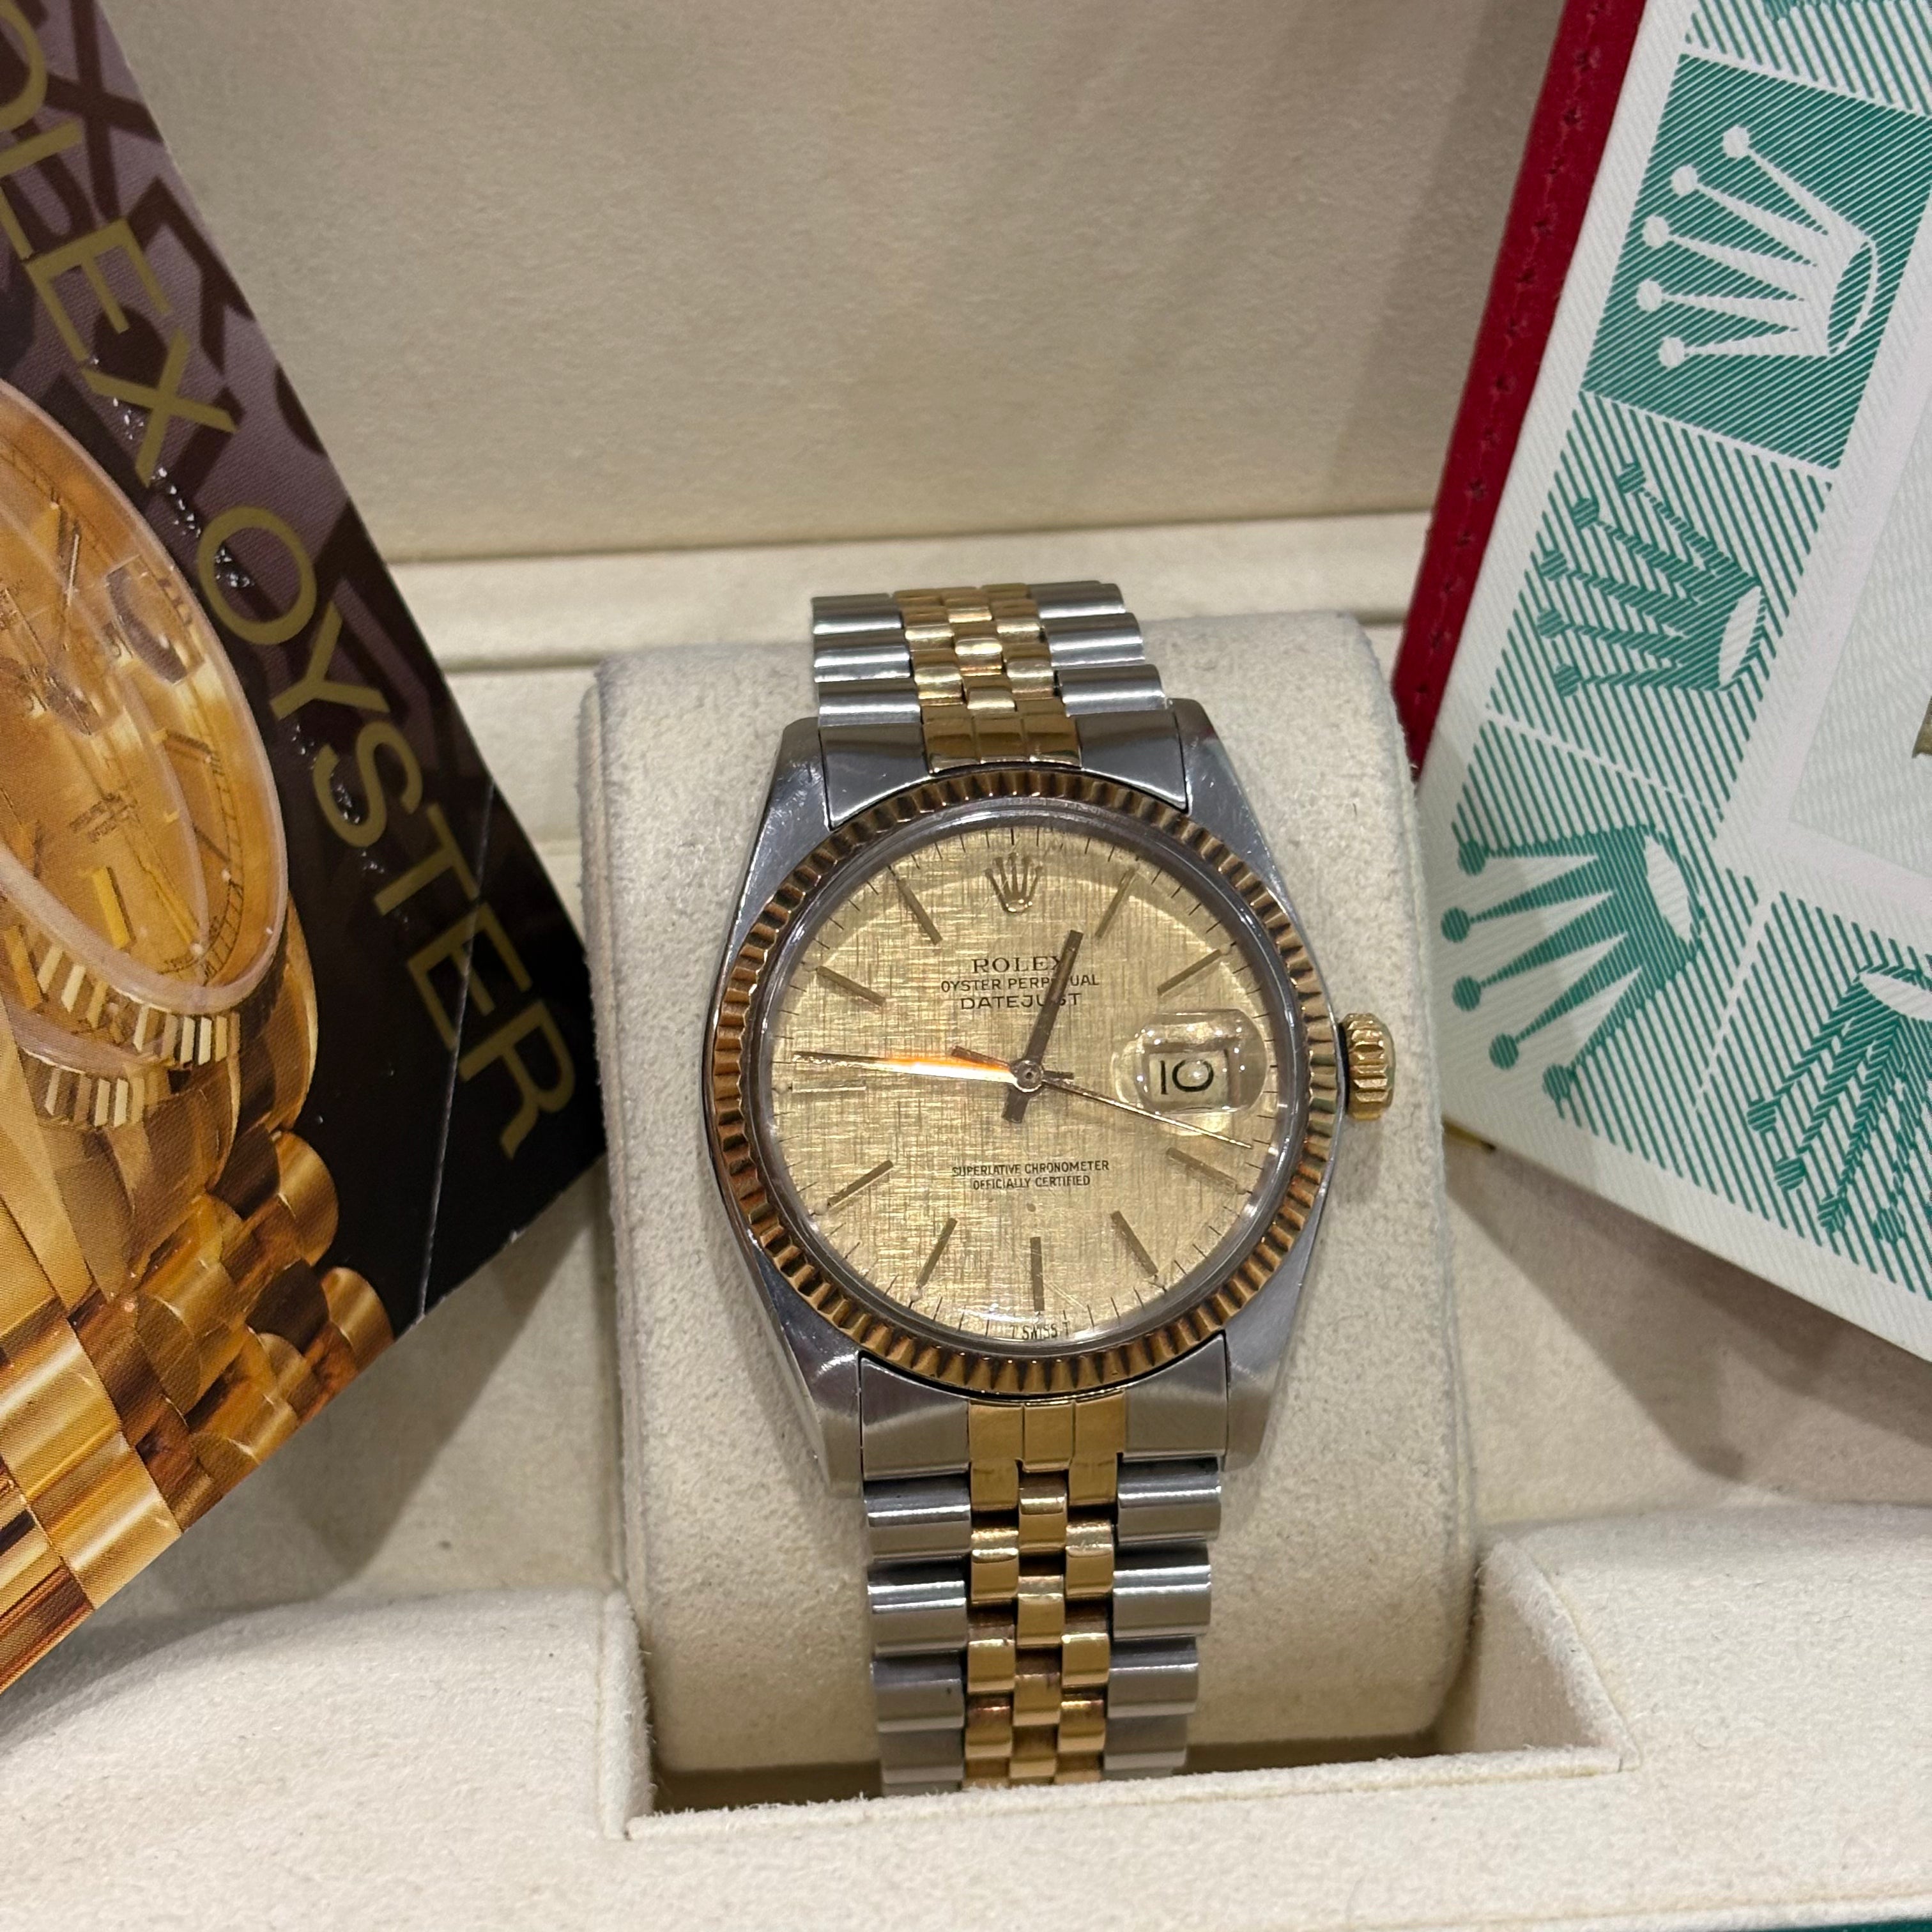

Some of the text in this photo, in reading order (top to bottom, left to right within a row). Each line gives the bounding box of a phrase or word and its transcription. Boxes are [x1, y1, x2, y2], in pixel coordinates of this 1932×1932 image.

[197, 506, 576, 1158] OYSTER
[941, 974, 1100, 992] OYSTER PERPUAL
[1160, 1059, 1214, 1094] 10
[951, 1160, 1110, 1177] SUPERLATIVE CHRONOMETER
[973, 1175, 1091, 1190] OFFICIALLY CERTIFIED
